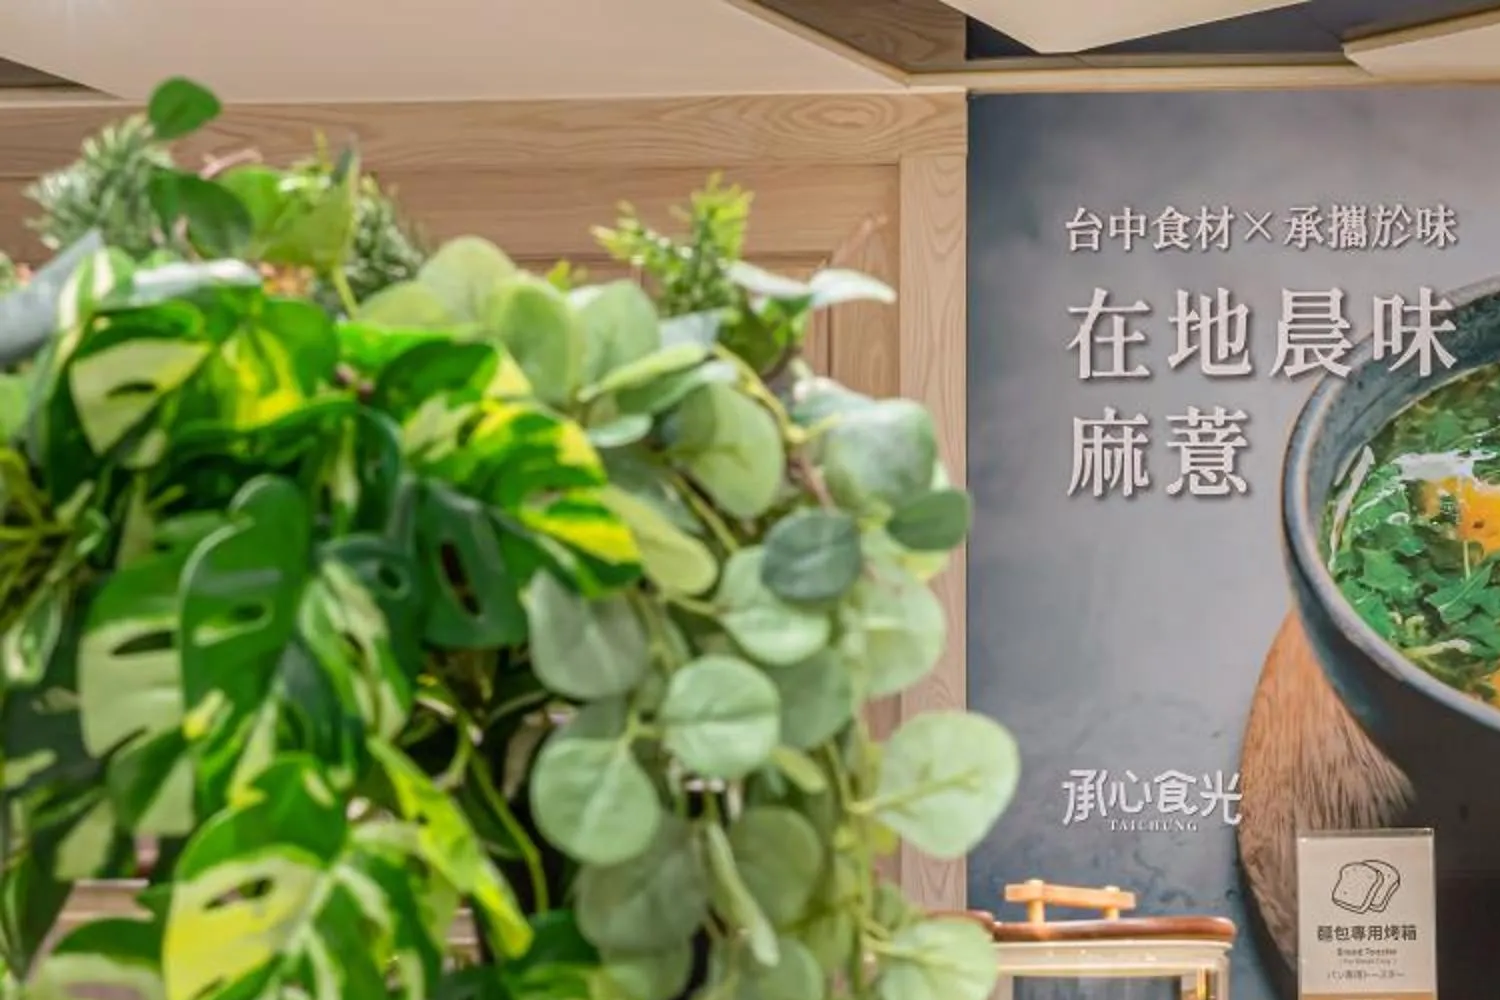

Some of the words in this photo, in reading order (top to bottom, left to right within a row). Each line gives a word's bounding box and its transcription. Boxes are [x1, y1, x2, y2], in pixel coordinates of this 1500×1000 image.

[1066, 286, 1458, 380] 在地晨味
[1066, 406, 1249, 498] 麻薏
[1061, 770, 1242, 825] 承心食光
[1110, 818, 1198, 831] TAICHUNG
